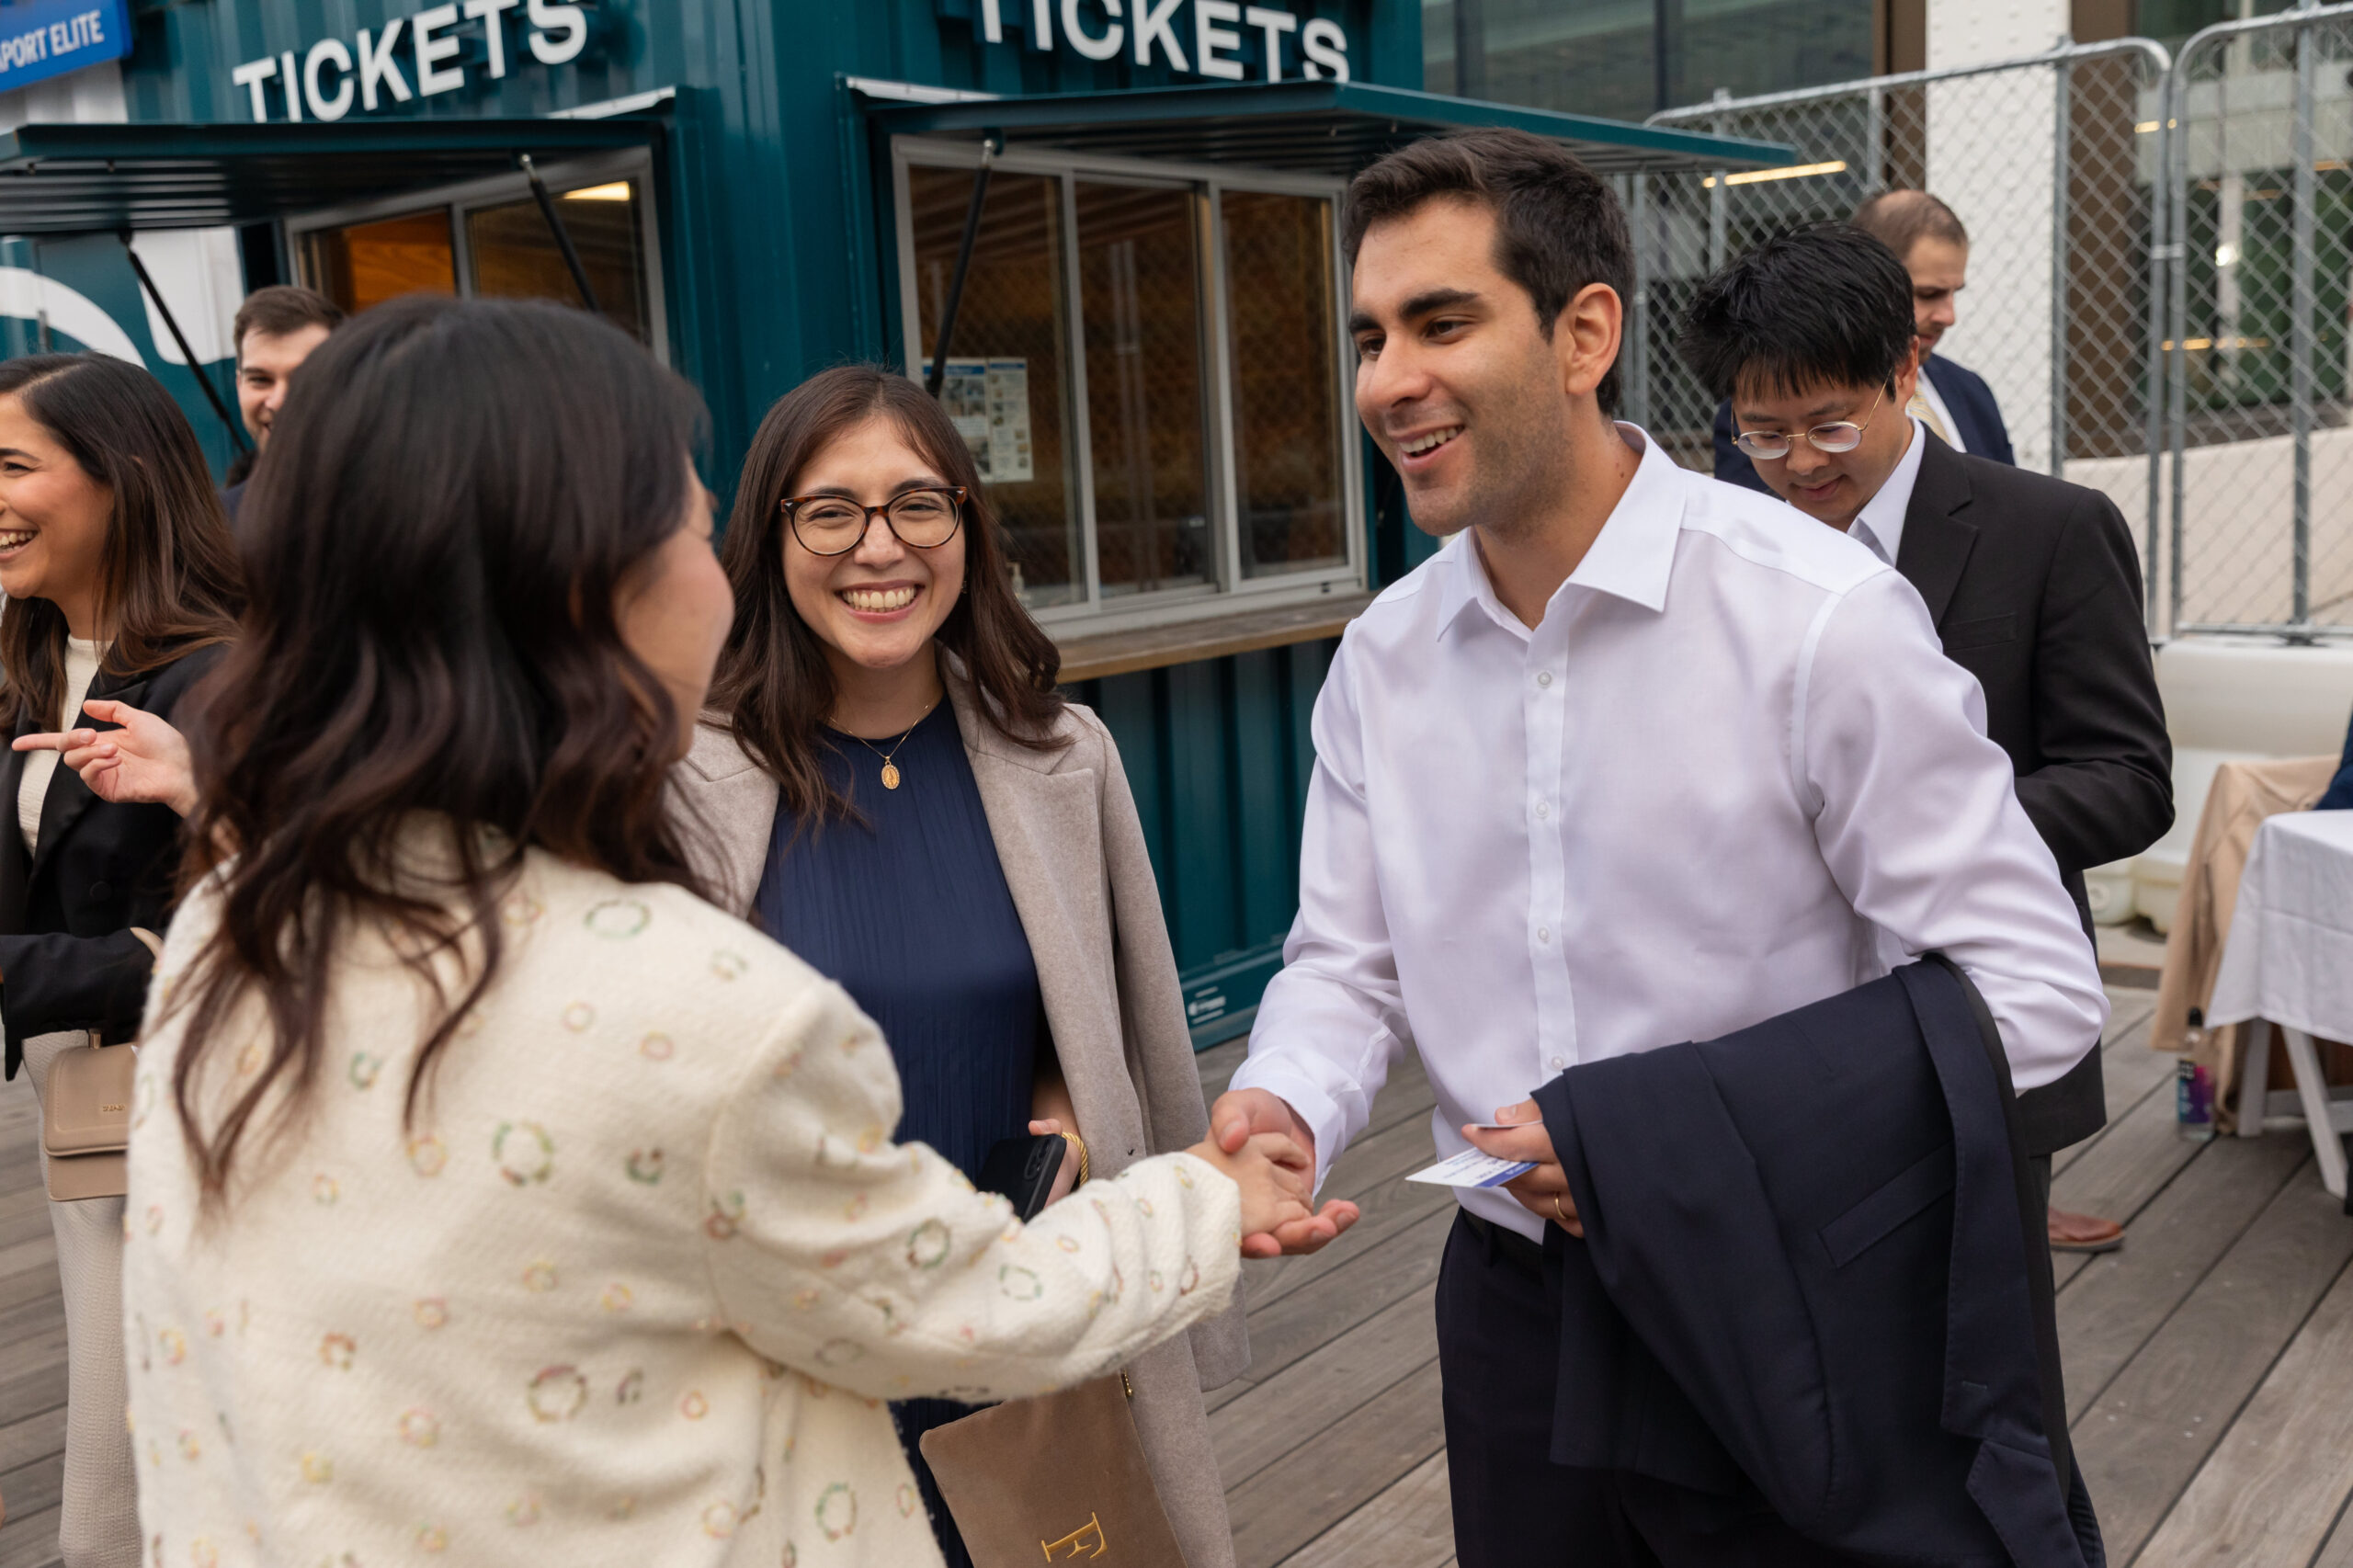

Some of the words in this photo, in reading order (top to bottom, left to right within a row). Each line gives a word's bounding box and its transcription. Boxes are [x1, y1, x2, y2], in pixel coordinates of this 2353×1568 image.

[0, 27, 47, 73] PORT
[50, 9, 105, 56] ELITE
[233, 0, 587, 123] TICKETS
